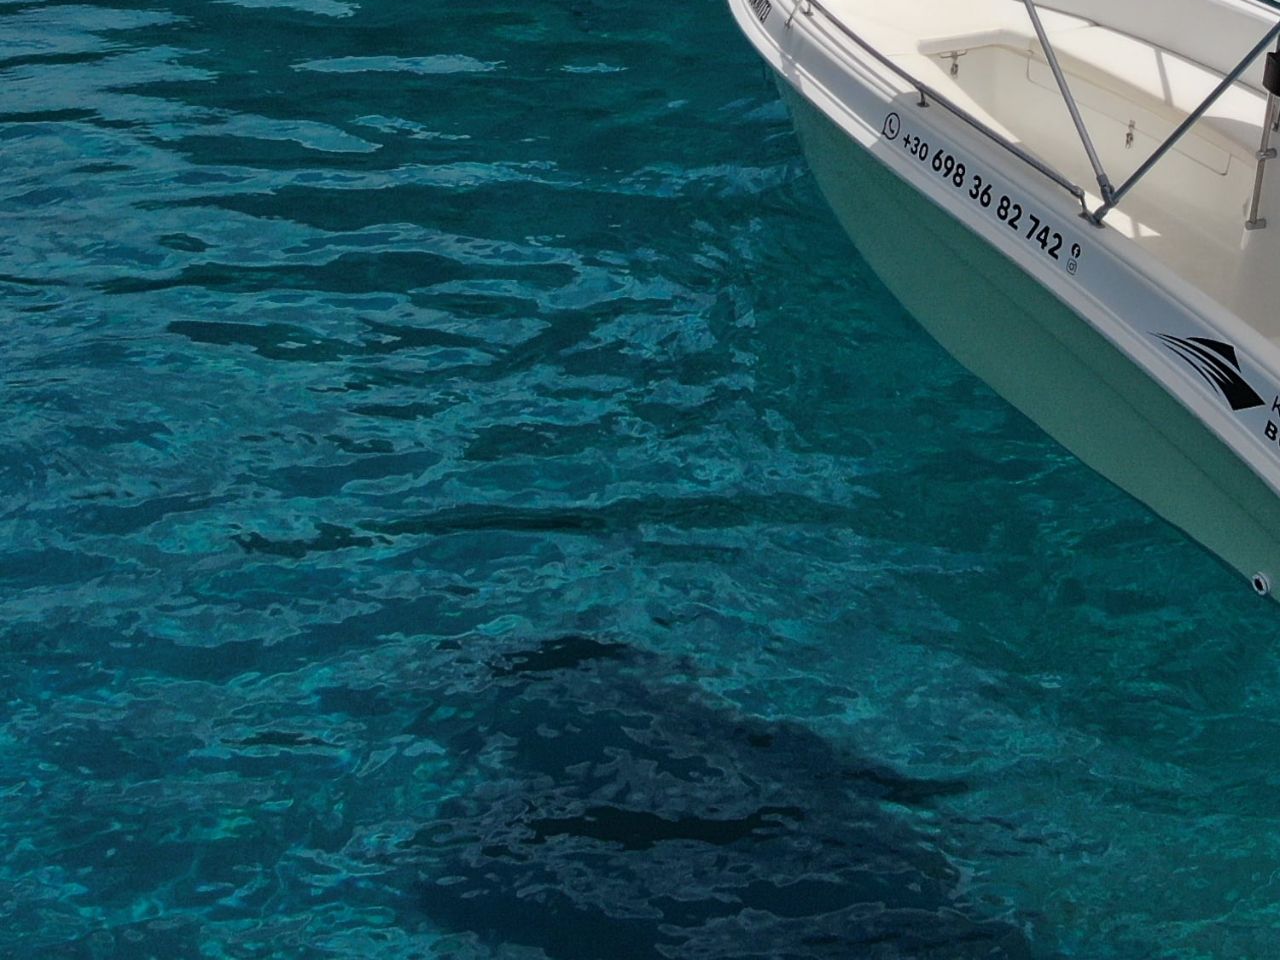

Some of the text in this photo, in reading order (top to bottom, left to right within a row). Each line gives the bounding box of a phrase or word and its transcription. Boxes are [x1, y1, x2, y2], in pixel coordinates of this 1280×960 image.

[903, 134, 1063, 260] +30 698 36 82 742
